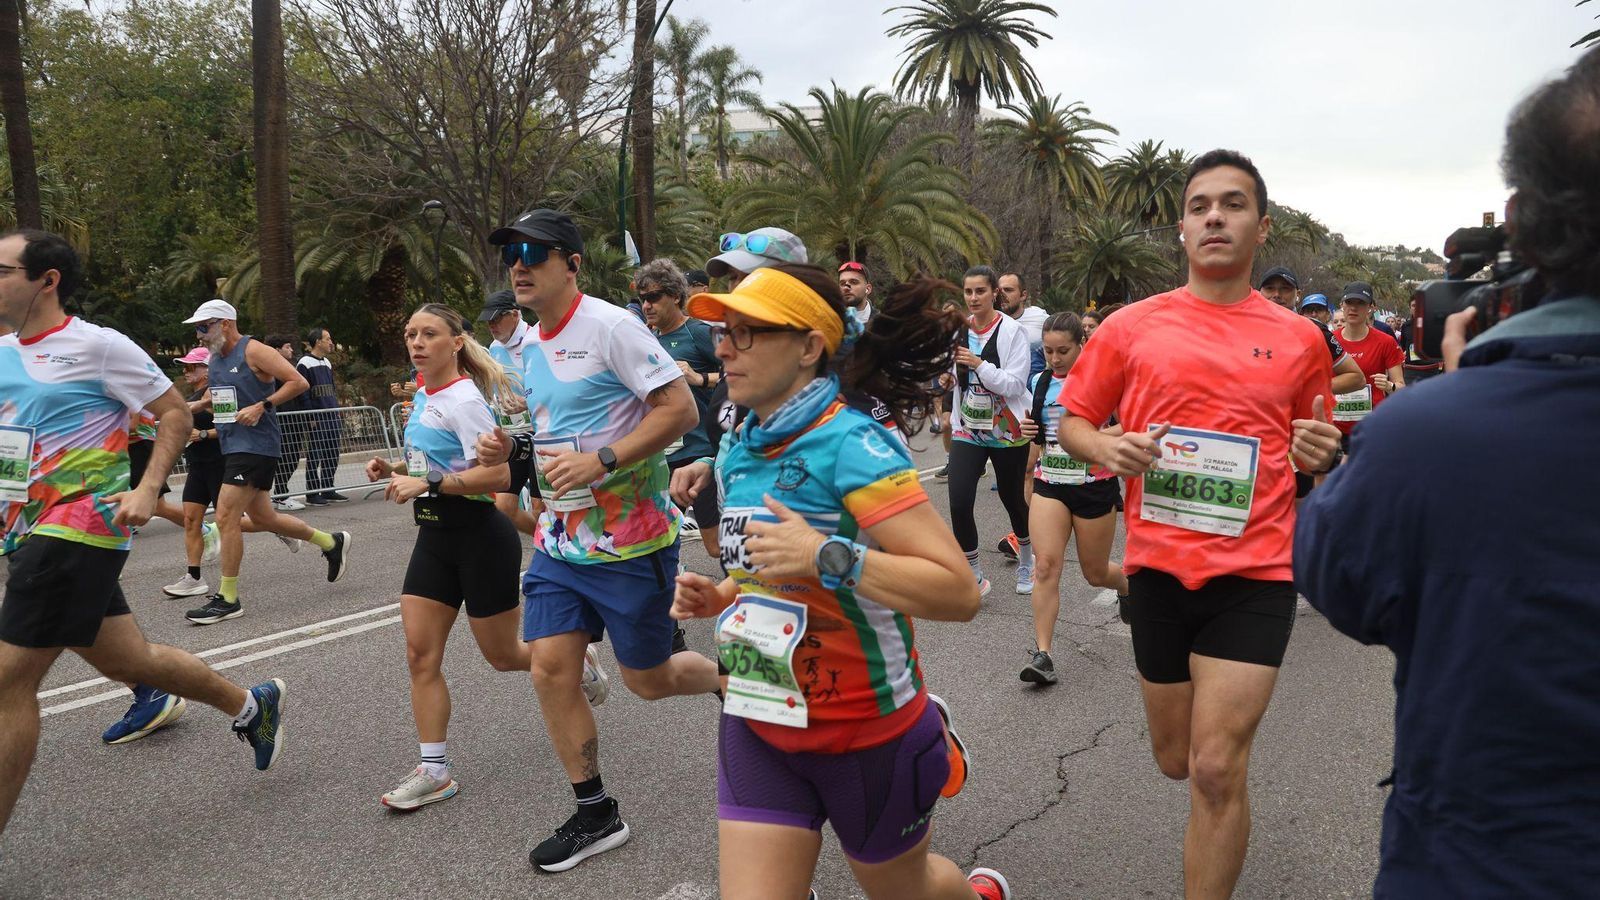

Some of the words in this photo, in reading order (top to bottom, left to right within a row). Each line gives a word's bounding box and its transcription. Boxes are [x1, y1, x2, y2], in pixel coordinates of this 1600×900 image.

[1338, 402, 1366, 411] 6035
[1046, 456, 1076, 470] 6295
[1164, 472, 1234, 504] 4863
